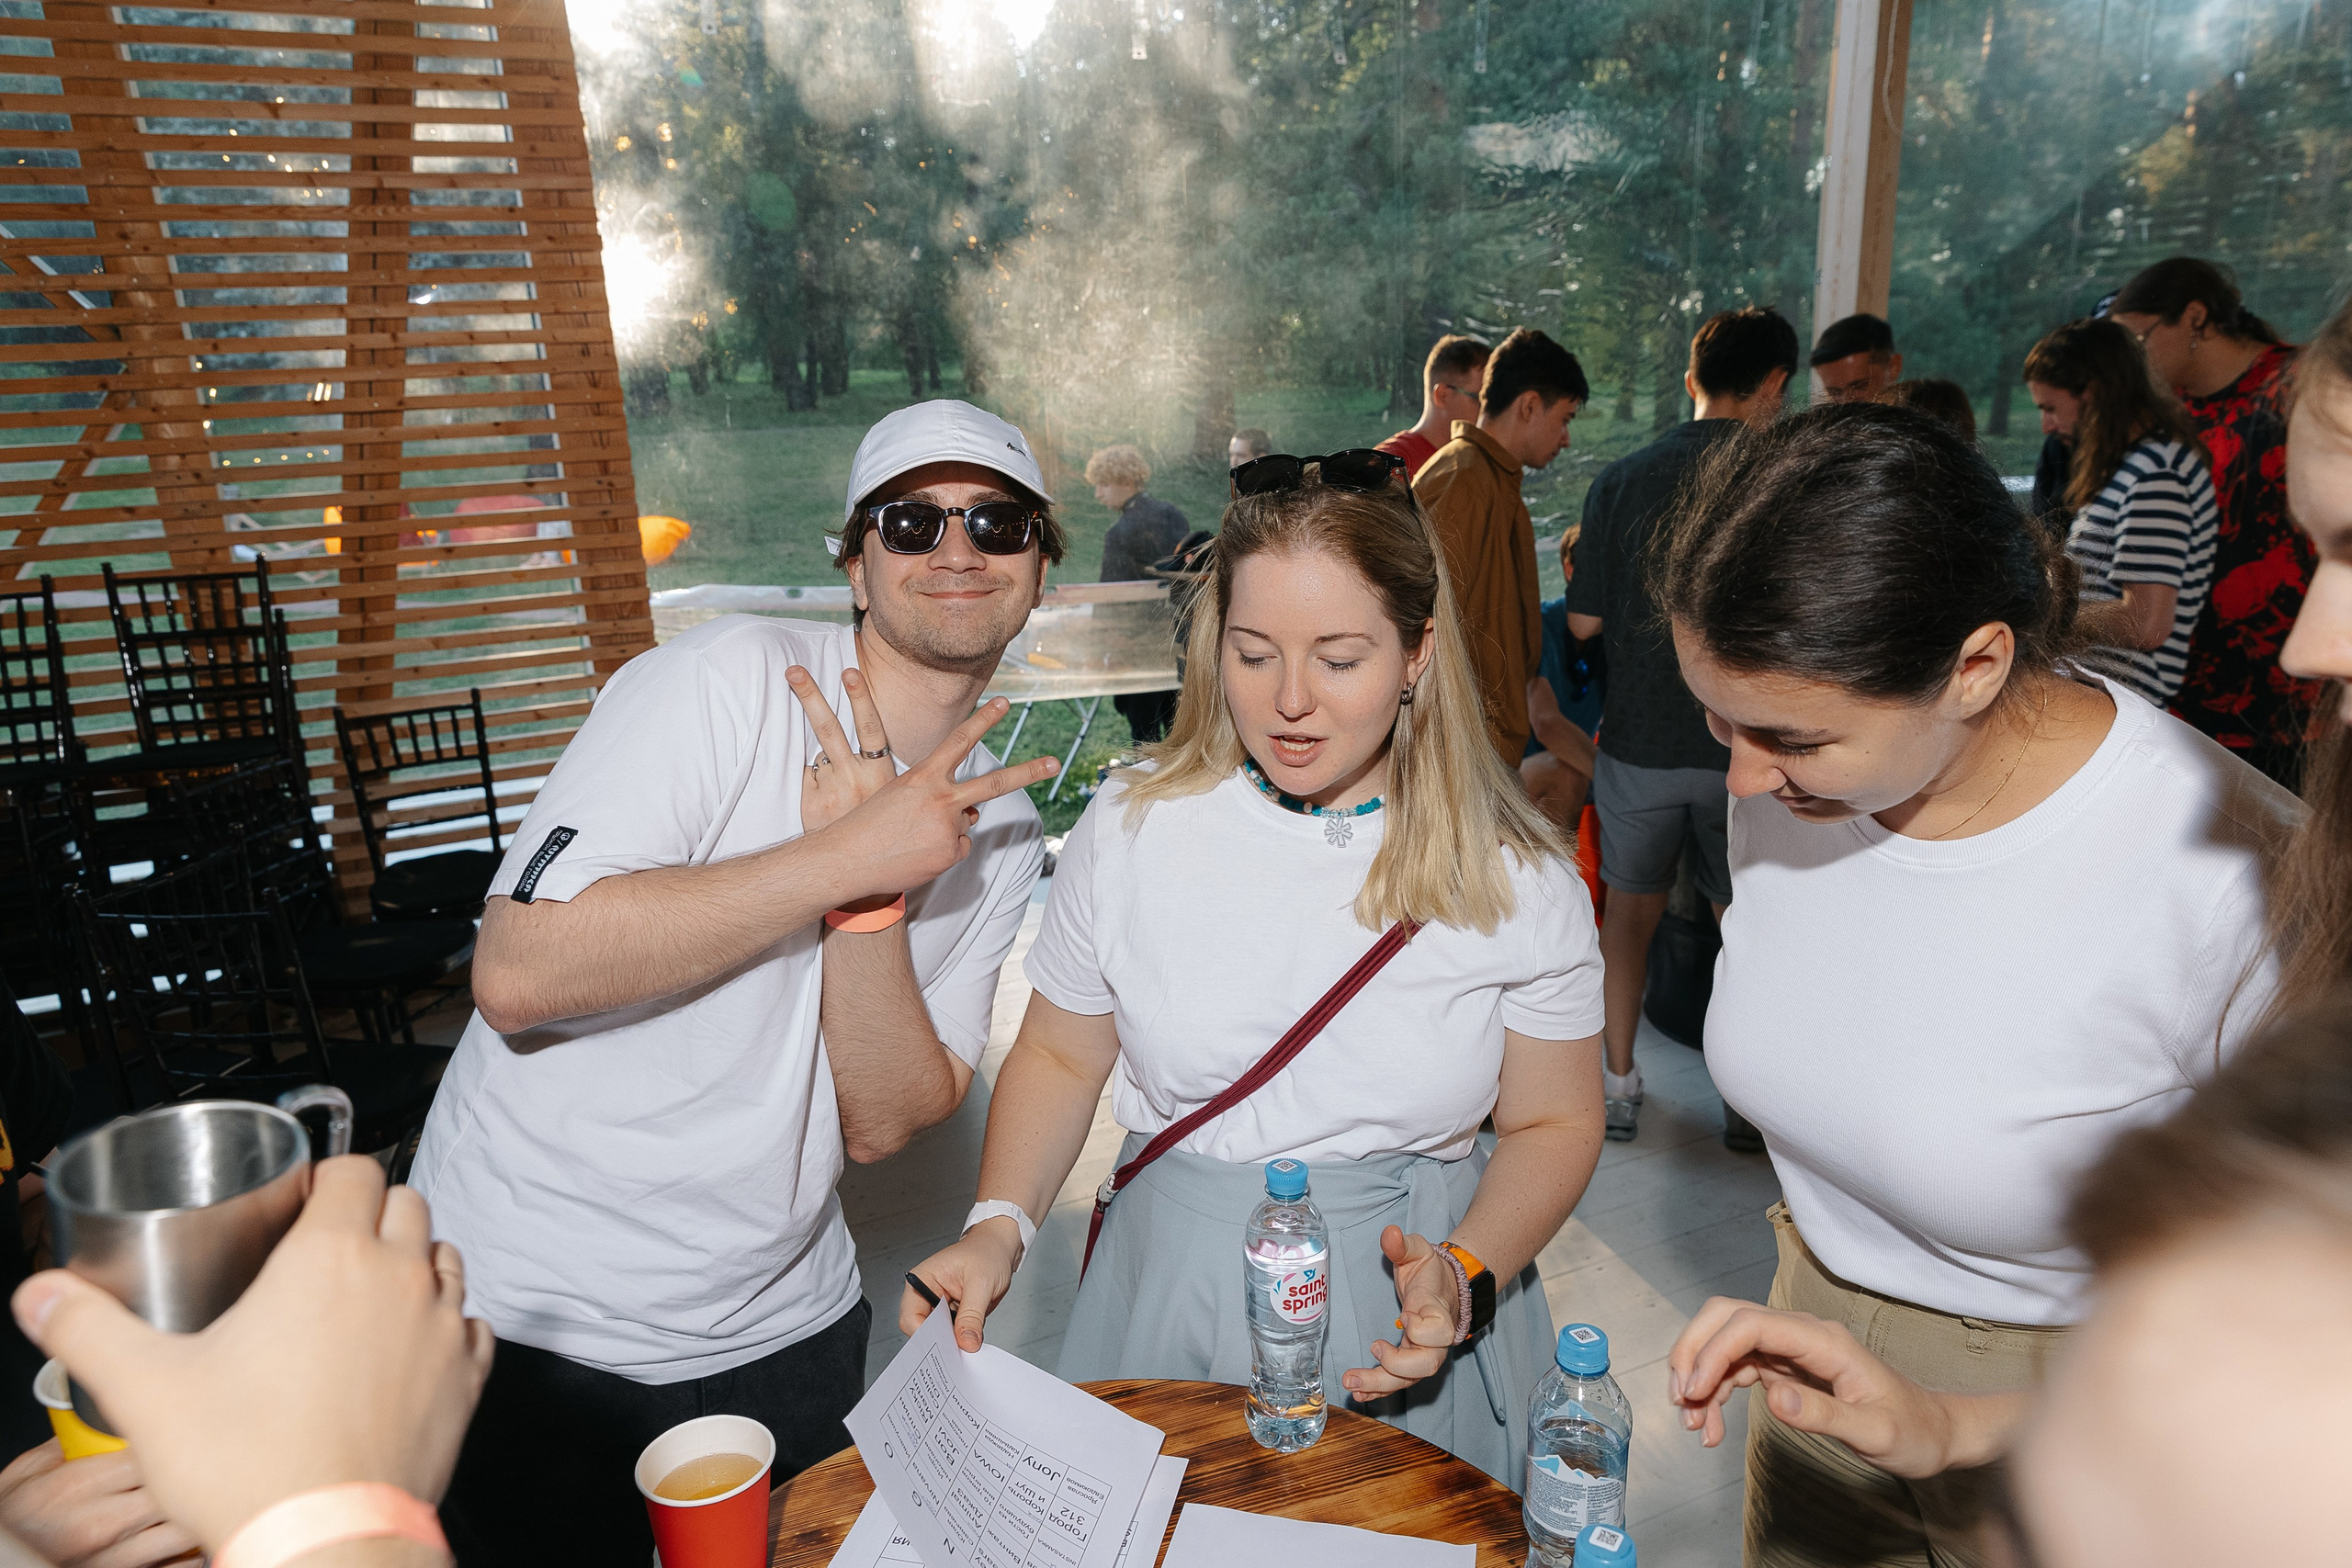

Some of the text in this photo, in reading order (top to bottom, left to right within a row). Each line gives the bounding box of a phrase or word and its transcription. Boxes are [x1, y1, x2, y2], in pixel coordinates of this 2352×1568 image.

[1282, 1284, 1328, 1314] spring
[1288, 1273, 1326, 1297] saint
[912, 1378, 933, 1419] Martin
[920, 1369, 939, 1409] Celine
[925, 1369, 940, 1398] Dion
[899, 1396, 922, 1439] Сплин
[910, 1387, 928, 1424] Ricky
[952, 1394, 980, 1429] Корни
[887, 1413, 910, 1459] Иванушки
[934, 1434, 955, 1466] Bon
[938, 1426, 960, 1455] Jovi
[984, 1434, 1014, 1459] Надежда
[985, 1428, 1020, 1455] Кадышева
[924, 1441, 951, 1483] Николаев
[927, 1453, 944, 1479] Игорь
[973, 1449, 1005, 1483] IOWA
[1022, 1455, 1061, 1481] Jony
[911, 1490, 922, 1507] G
[912, 1461, 940, 1506] Nirvana
[961, 1470, 992, 1506] 10 треков
[982, 1487, 996, 1501] вне
[1013, 1481, 1046, 1504] и Шут
[1066, 1477, 1105, 1501] Евдокимов
[1067, 1485, 1099, 1505] Ярослав
[950, 1491, 982, 1529] Animal
[1008, 1485, 1045, 1516] Король
[944, 1506, 974, 1546] Савичева
[946, 1518, 966, 1544] Юлия
[998, 1510, 1030, 1540] Гости из
[999, 1503, 1035, 1534] будущего
[1048, 1512, 1088, 1542] Город
[1060, 1506, 1086, 1526] 312
[943, 1537, 956, 1555] N
[987, 1528, 1022, 1564] Винтаж
[1036, 1538, 1077, 1567] INSTASAMKA
